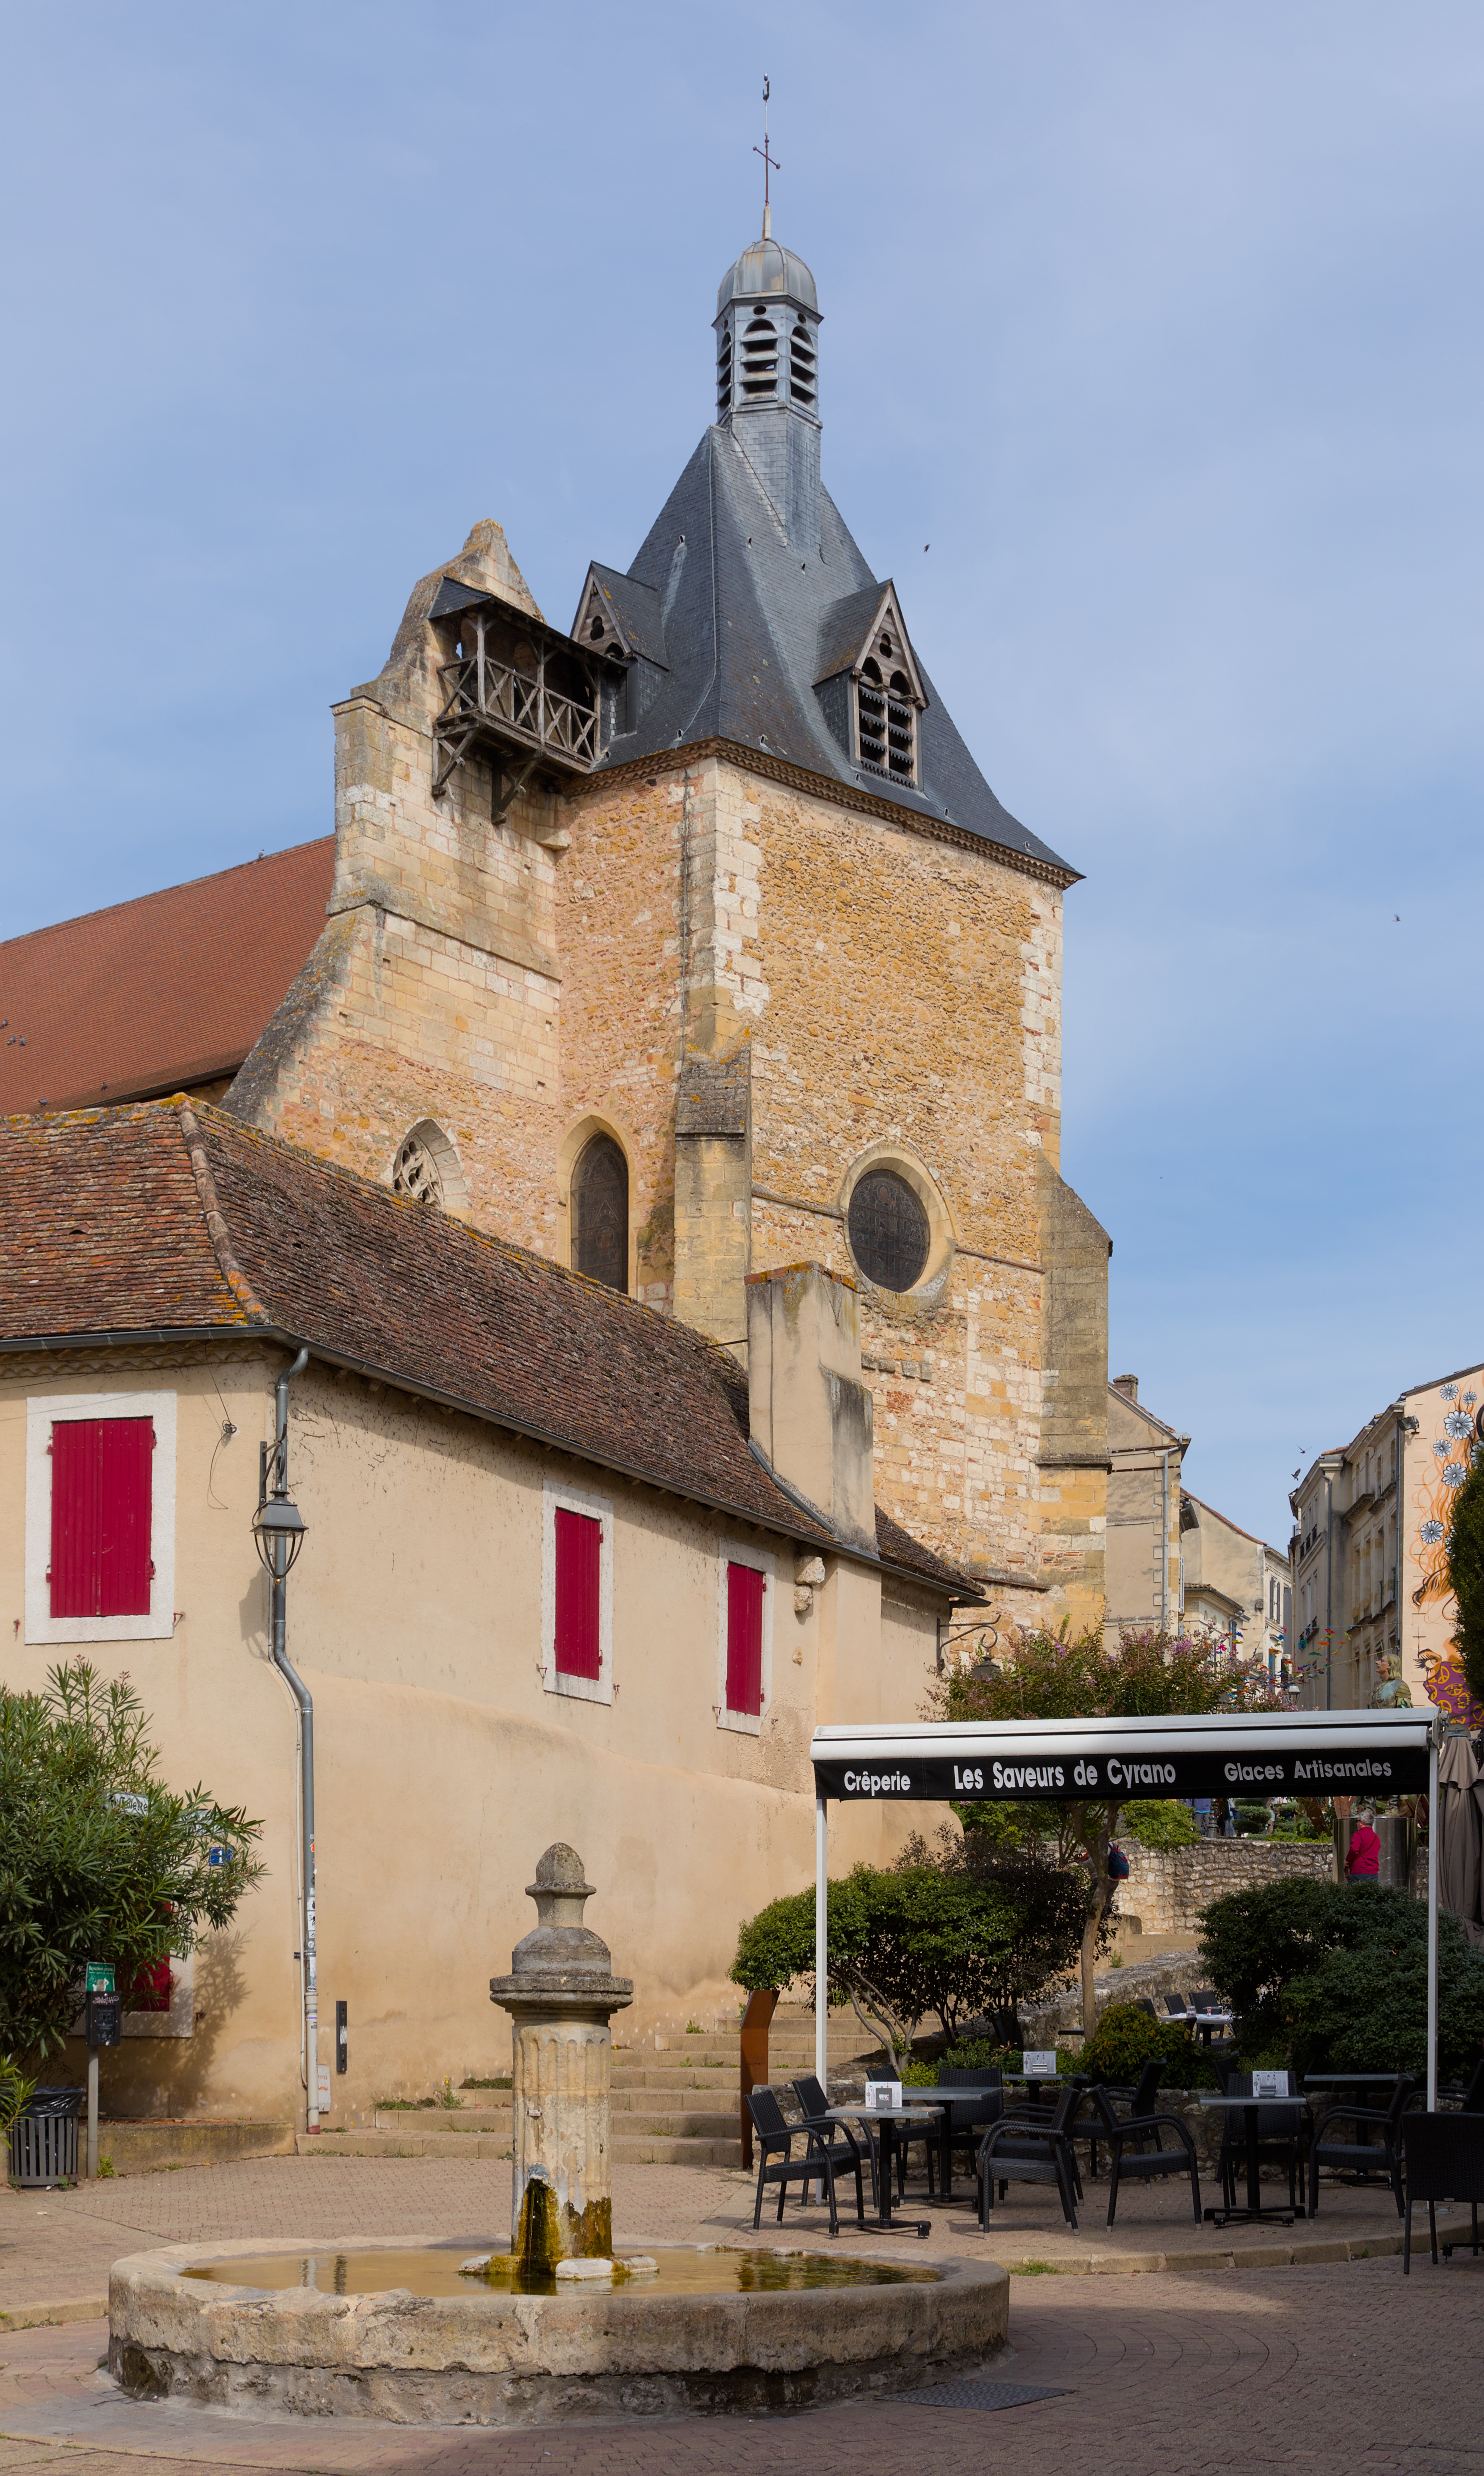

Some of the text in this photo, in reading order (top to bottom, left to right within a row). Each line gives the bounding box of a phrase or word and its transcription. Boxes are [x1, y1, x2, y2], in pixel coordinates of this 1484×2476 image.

[954, 1758, 1176, 1790] Les Saveurs de Cyrano
[1224, 1759, 1392, 1781] Glaces Artisanales
[844, 1770, 911, 1797] Crêperie
[218, 1850, 223, 1863] 1
